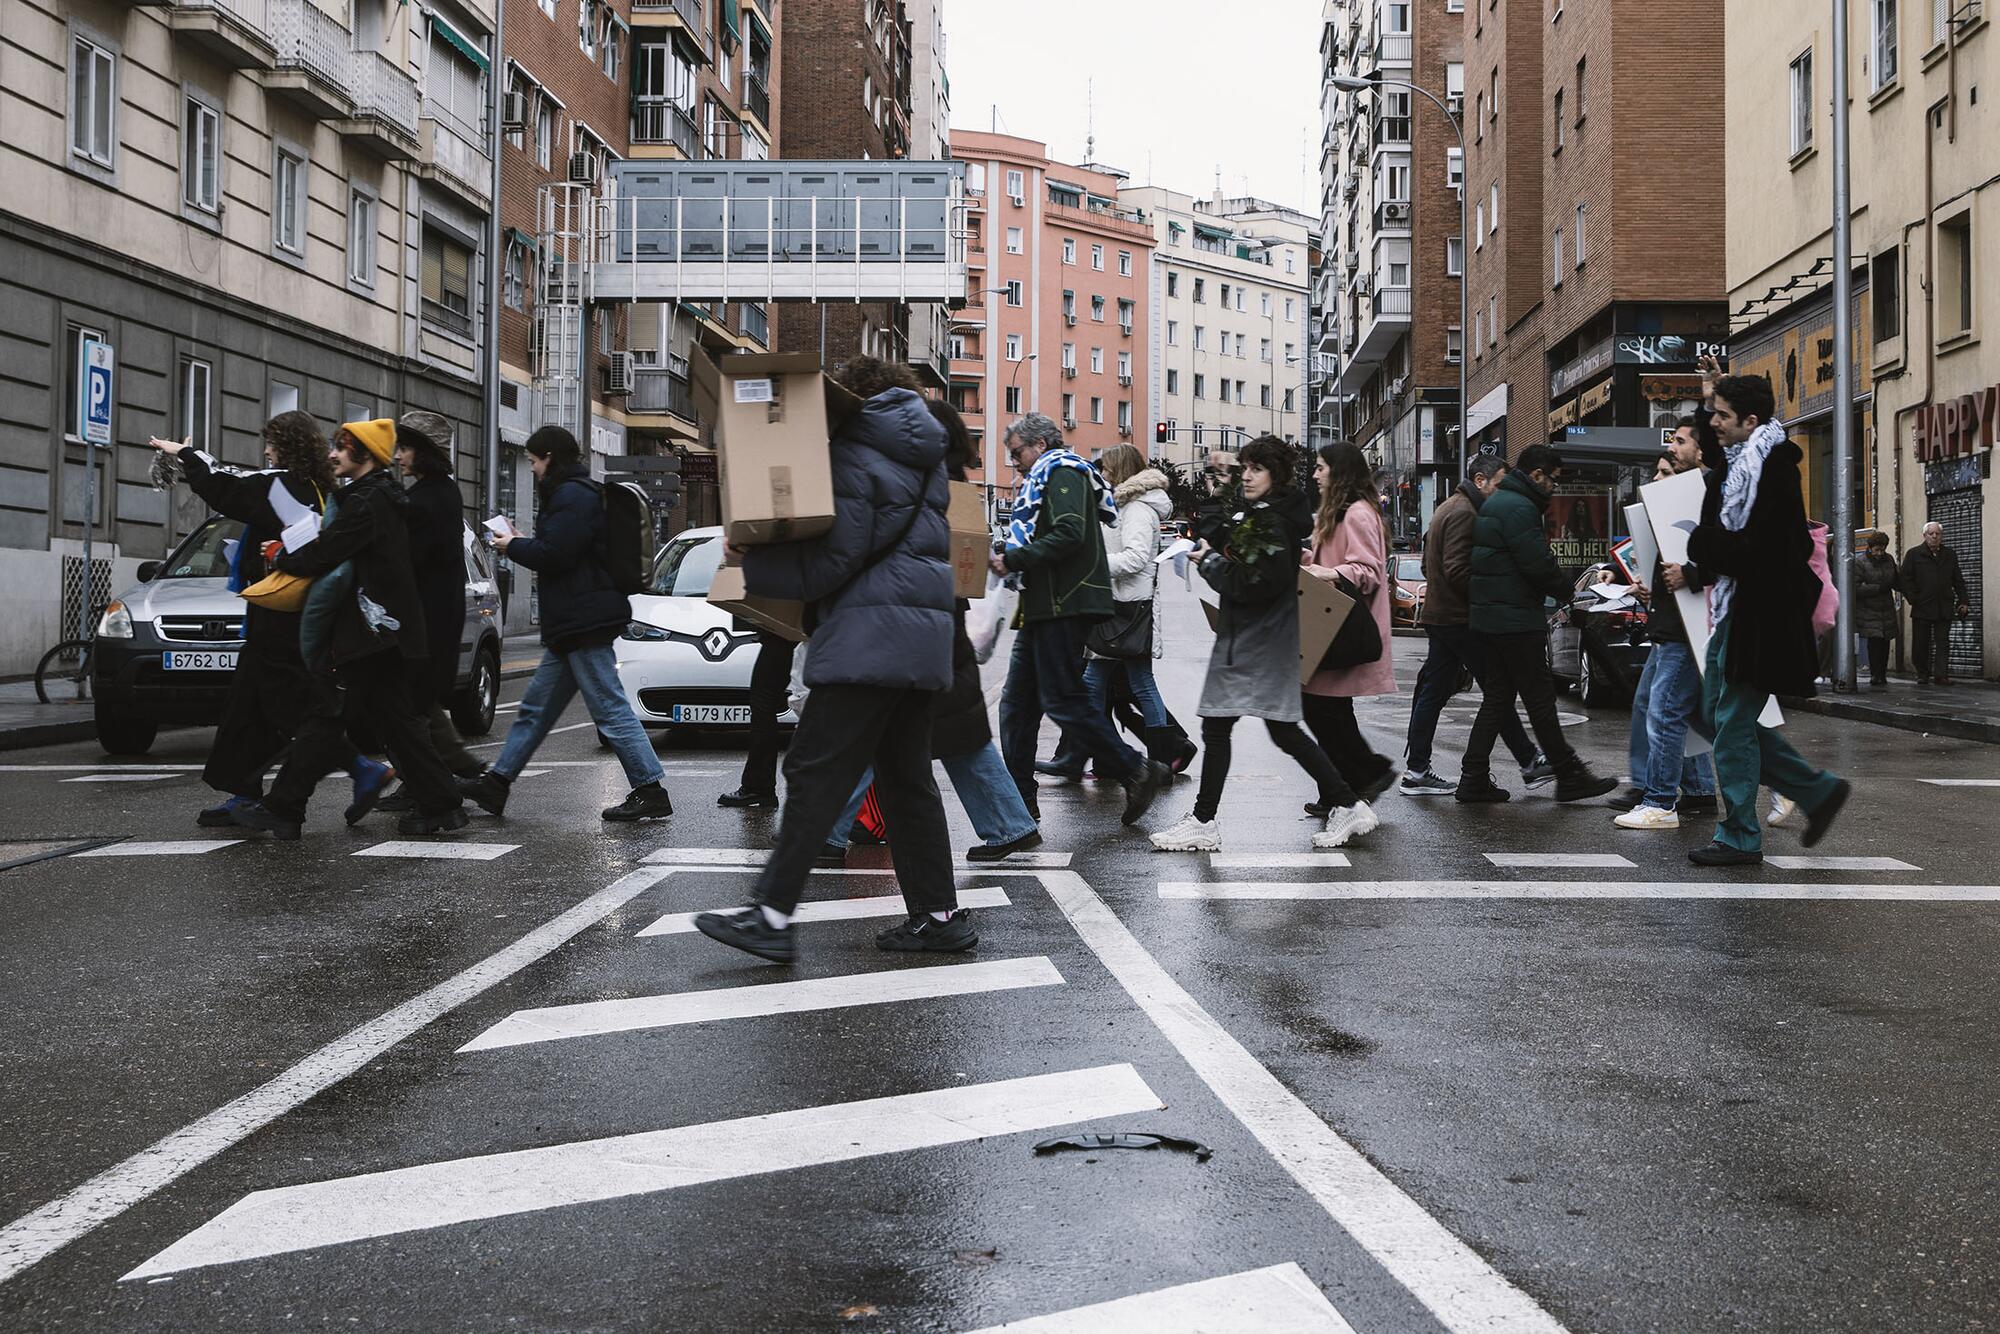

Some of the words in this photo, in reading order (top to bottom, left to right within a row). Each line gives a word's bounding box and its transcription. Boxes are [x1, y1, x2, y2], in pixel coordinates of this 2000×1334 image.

[90, 371, 106, 418] P
[1550, 542, 1580, 556] SEND
[174, 653, 213, 668] 6762
[218, 653, 238, 668] CL
[683, 707, 719, 721] 8179
[723, 707, 751, 721] KFP
